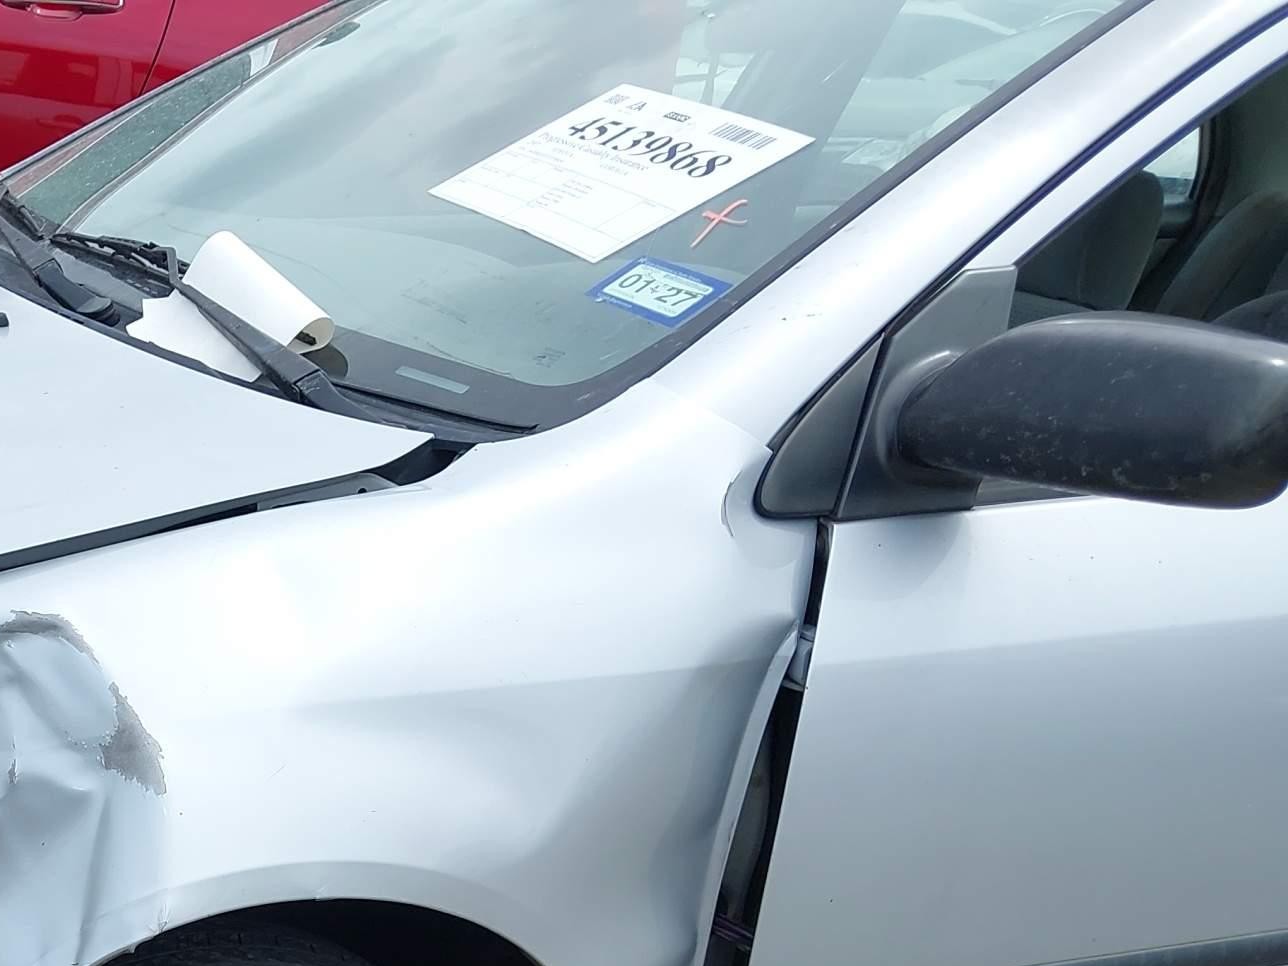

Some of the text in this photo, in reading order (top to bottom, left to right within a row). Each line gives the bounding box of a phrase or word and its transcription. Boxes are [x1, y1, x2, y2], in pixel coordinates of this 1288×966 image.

[568, 117, 733, 178] 45139868
[618, 273, 657, 294] 01
[653, 286, 699, 307] 27
